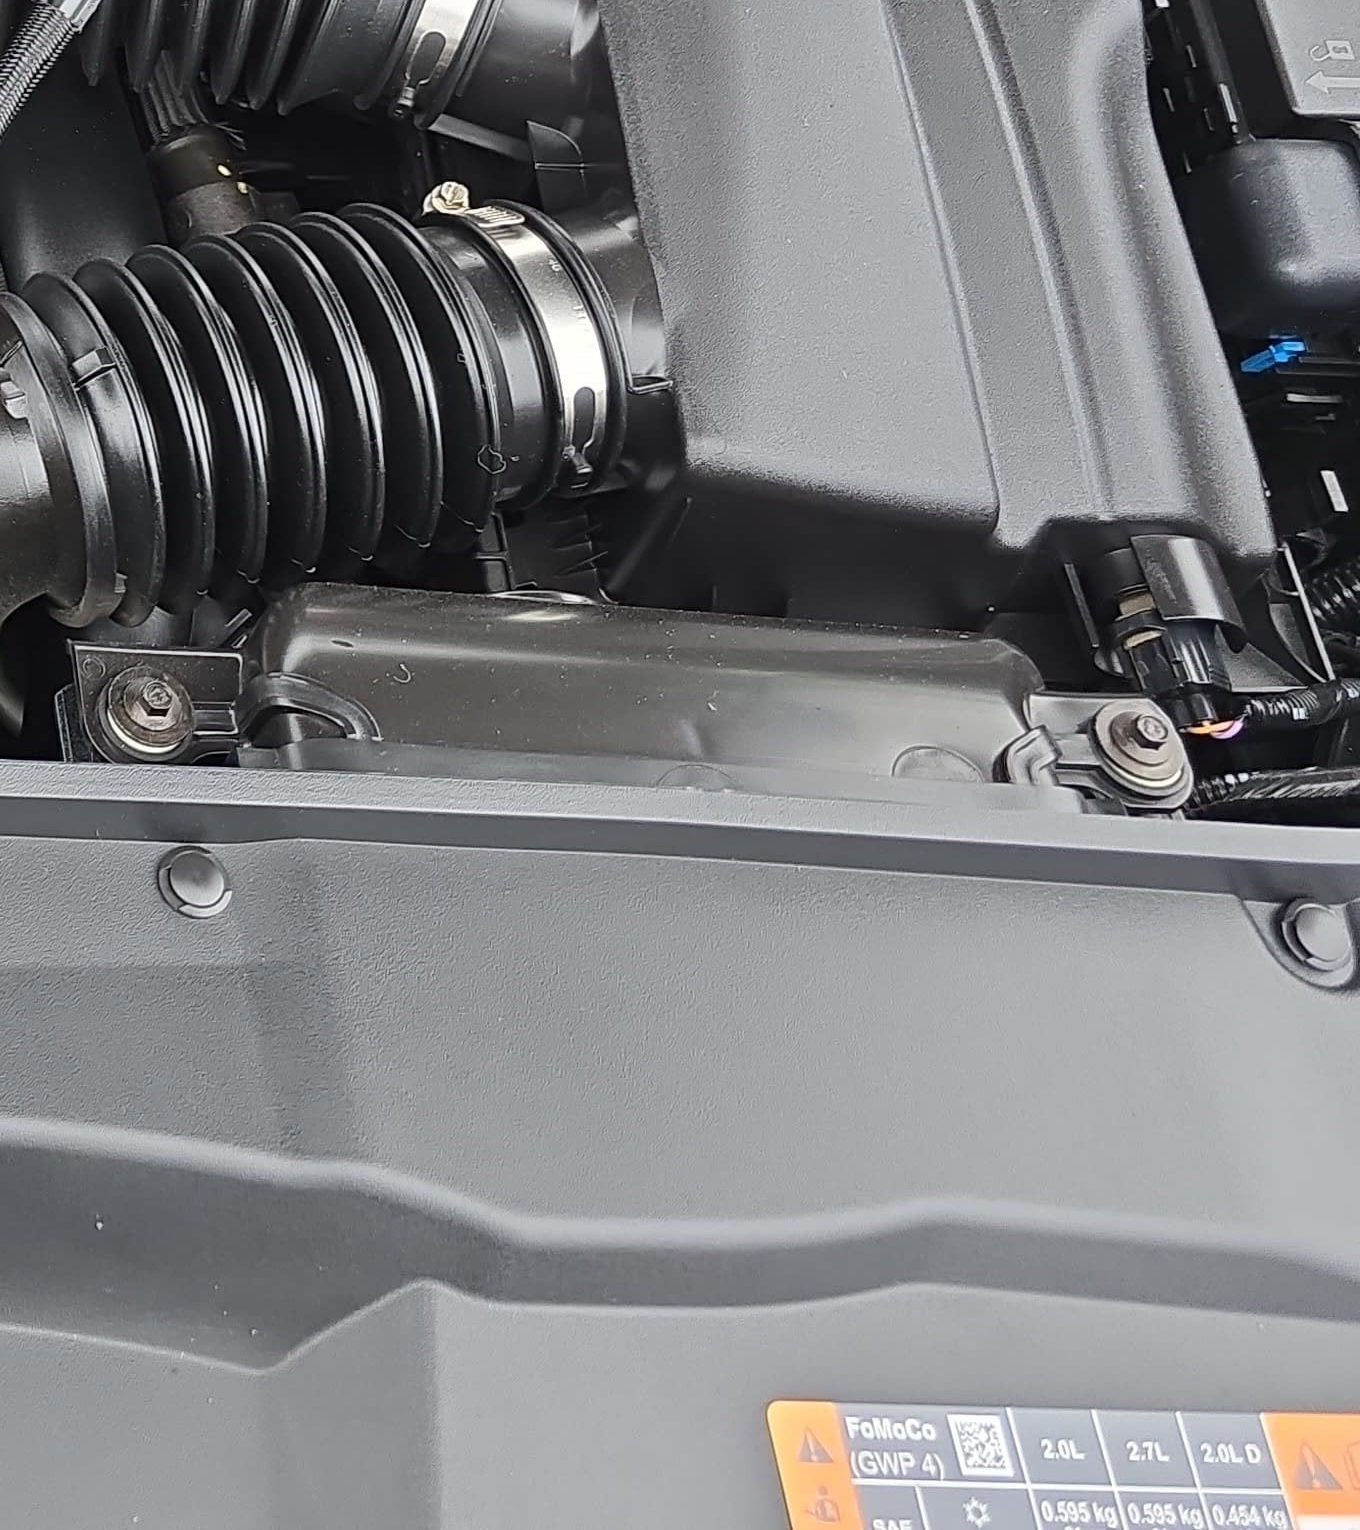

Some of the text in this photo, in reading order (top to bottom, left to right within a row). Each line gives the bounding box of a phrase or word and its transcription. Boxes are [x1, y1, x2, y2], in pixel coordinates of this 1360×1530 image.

[845, 1416, 937, 1442] FoMoCo
[1040, 1437, 1086, 1459] 2.0L
[1126, 1440, 1170, 1462] 2.7L
[1200, 1442, 1262, 1464] 2.0L D
[850, 1449, 945, 1480] (GWP 4)
[1041, 1501, 1117, 1530] 0.595 kg
[1127, 1503, 1204, 1530] 0.595 kg
[1211, 1504, 1288, 1530] 0.454 kg
